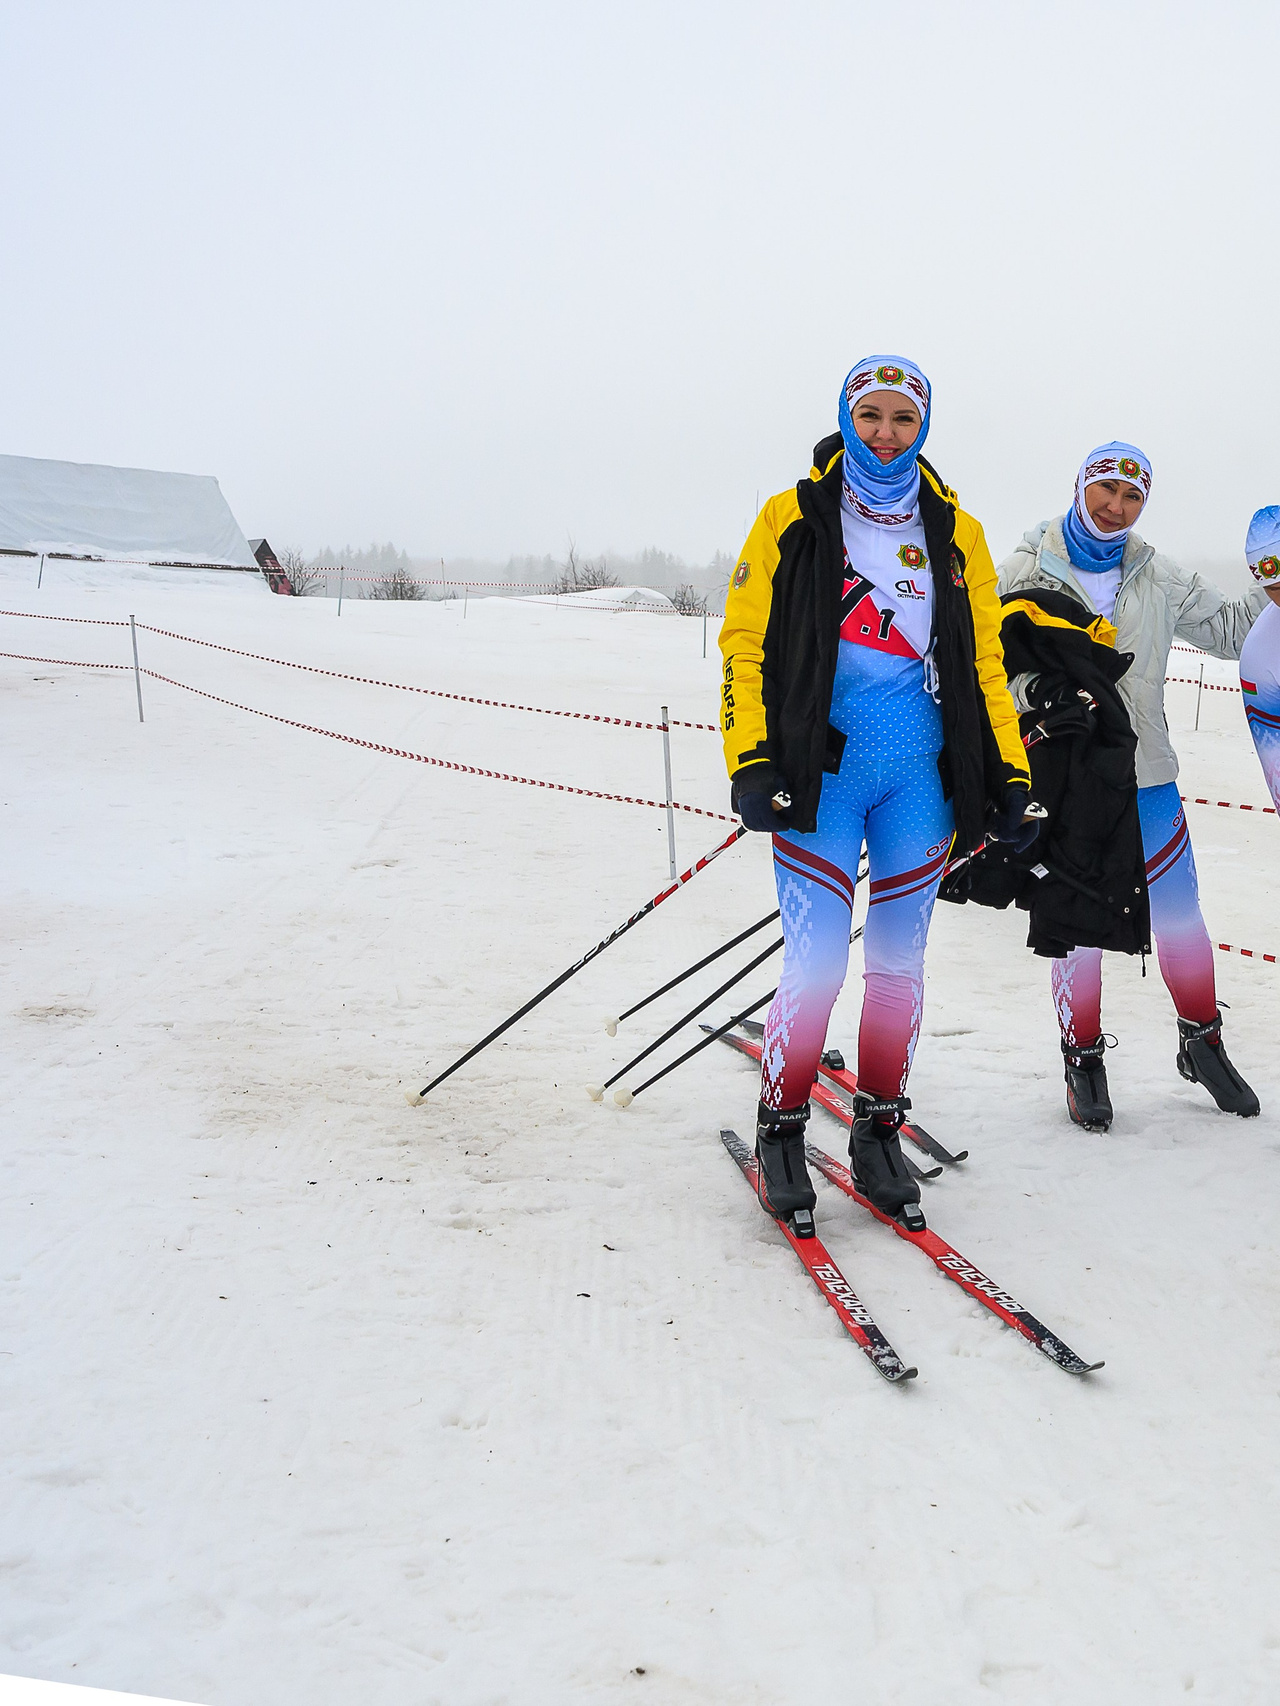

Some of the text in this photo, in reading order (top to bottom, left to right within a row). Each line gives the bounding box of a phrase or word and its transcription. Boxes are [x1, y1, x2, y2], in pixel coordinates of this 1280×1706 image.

[865, 1103, 899, 1111] MARAX
[811, 1263, 876, 1326] ТЕЛЕХАНЫ
[937, 1252, 1029, 1313] ТЕЛЕХАНЫ
